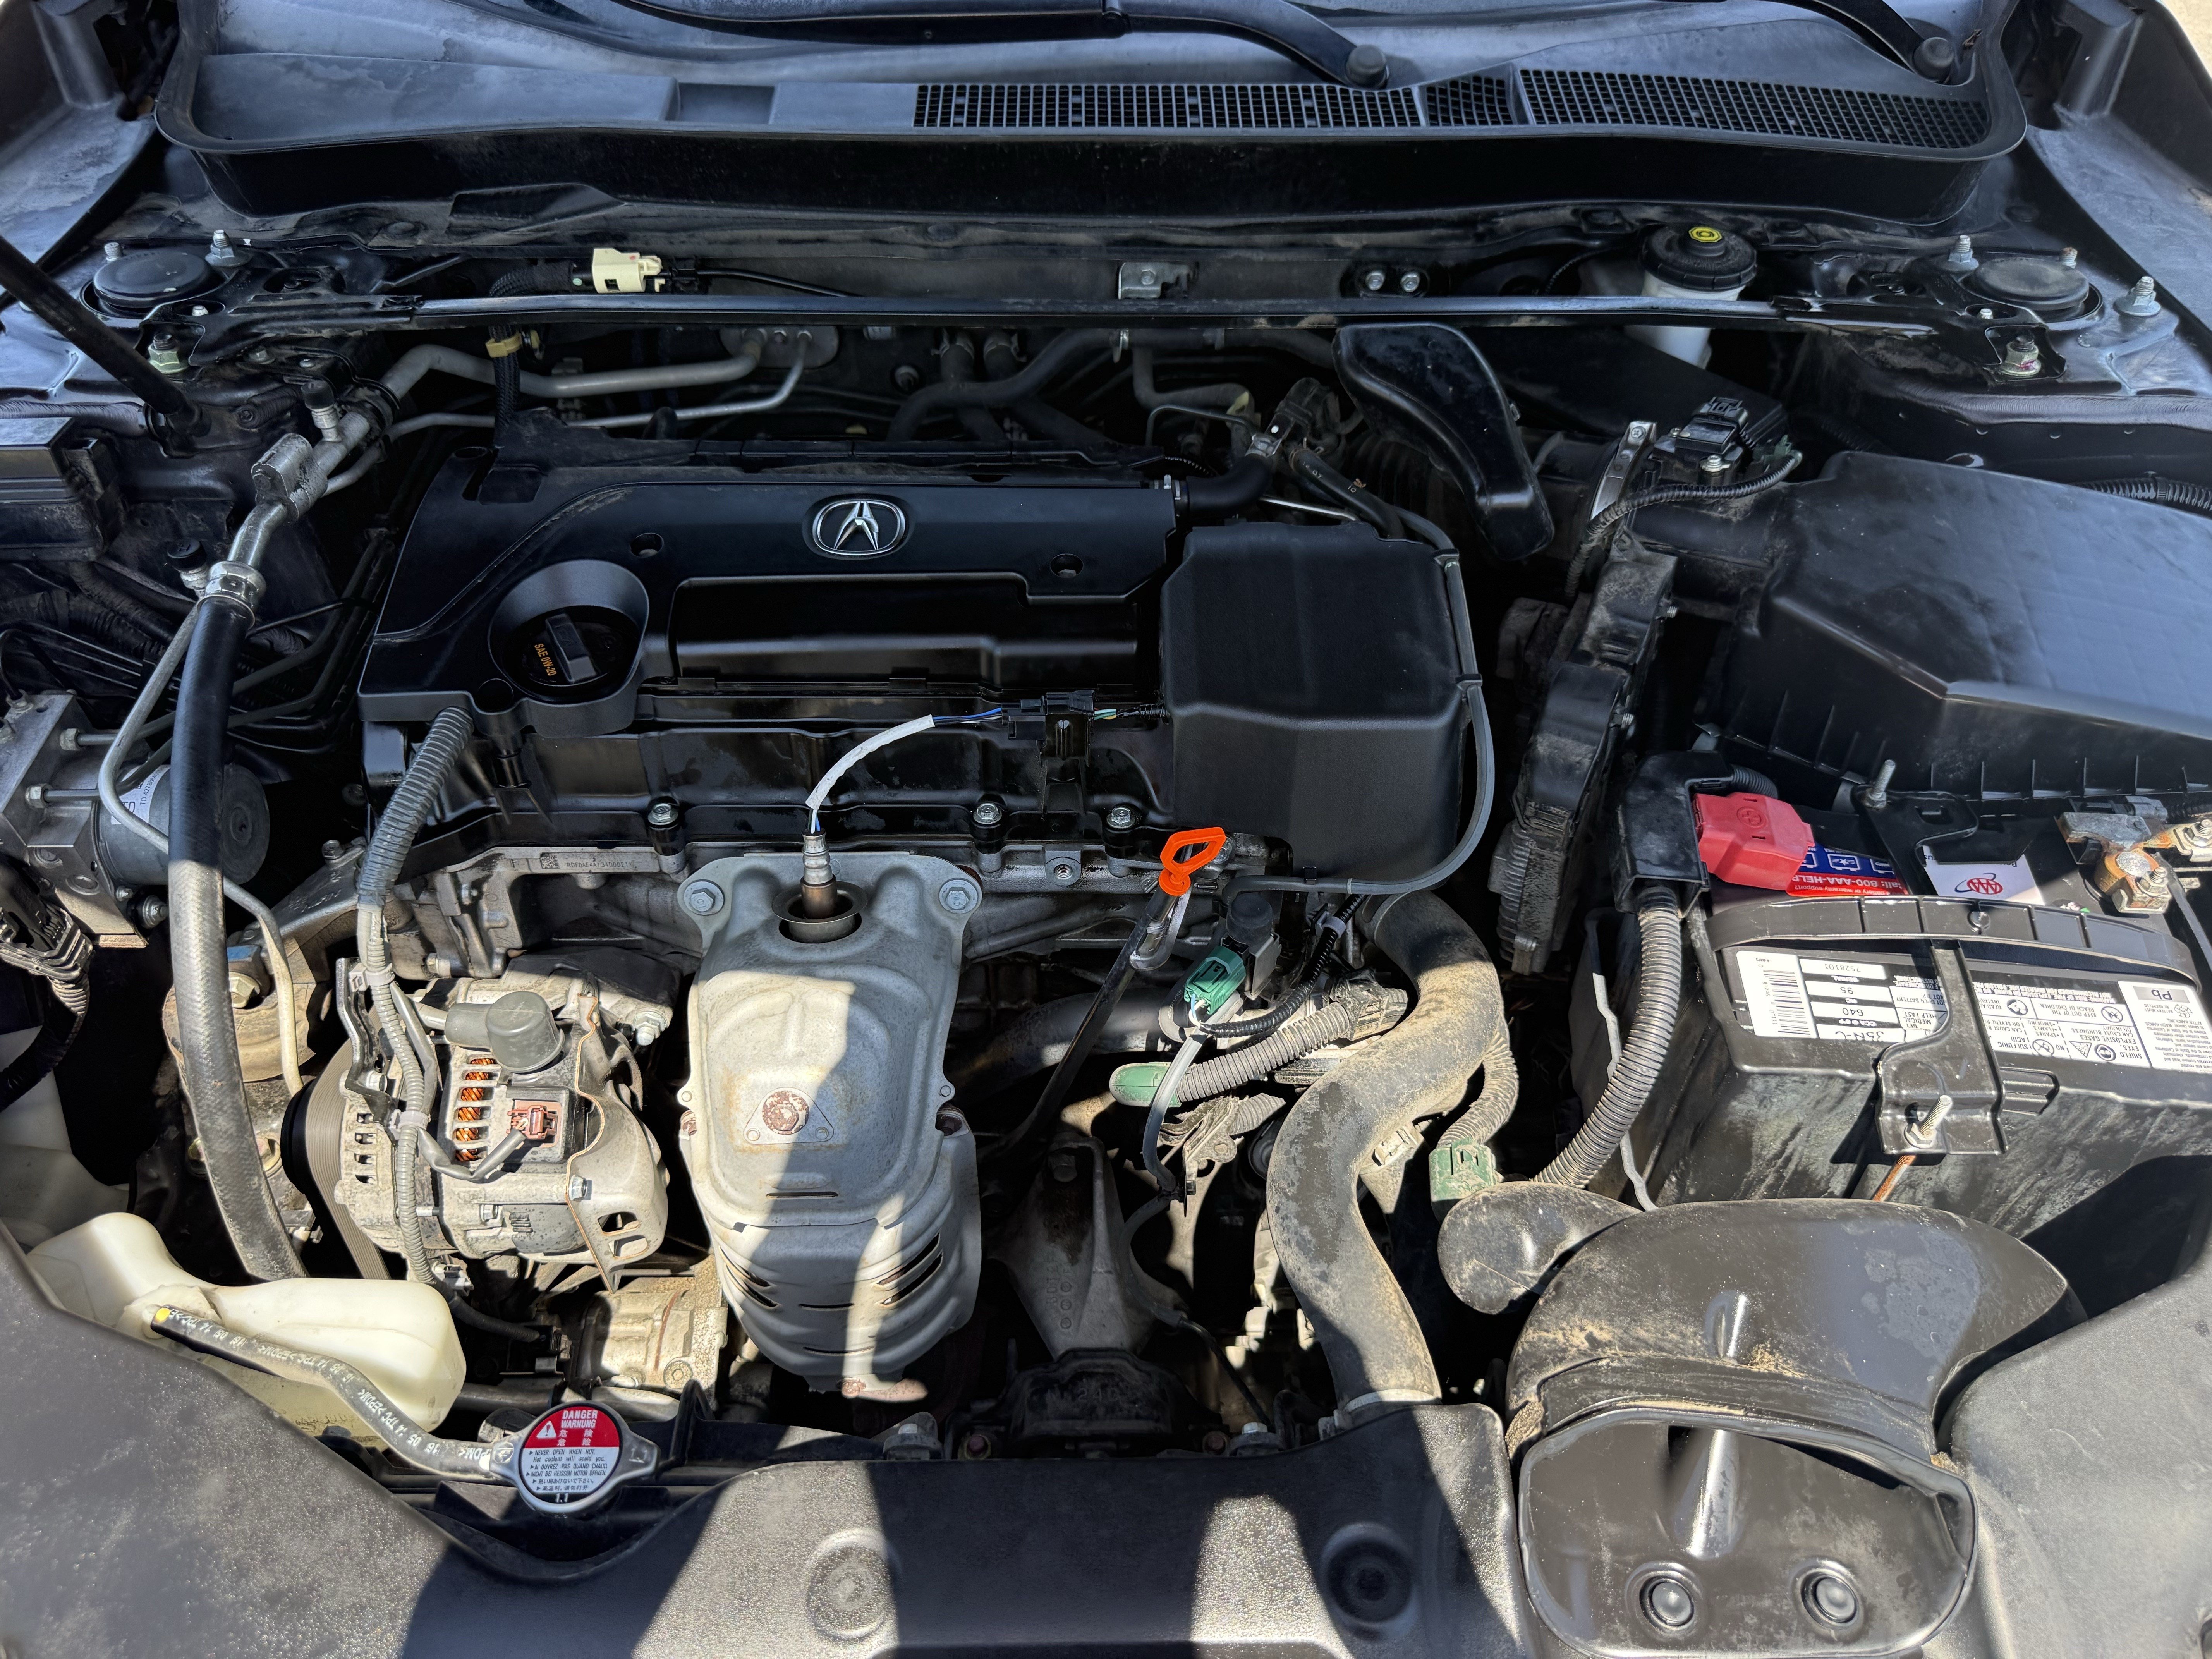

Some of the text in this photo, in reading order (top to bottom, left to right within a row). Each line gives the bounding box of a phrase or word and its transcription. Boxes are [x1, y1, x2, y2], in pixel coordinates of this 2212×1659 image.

[534, 643, 548, 657] SAE
[140, 797, 147, 805] TD
[1971, 878, 1998, 895] AAA
[1824, 963, 1861, 972] 7528101
[2151, 989, 2172, 1000] Pb
[1842, 1008, 1863, 1017] 640
[562, 1410, 598, 1419] DANGER
[561, 1419, 596, 1428] WARNUNG
